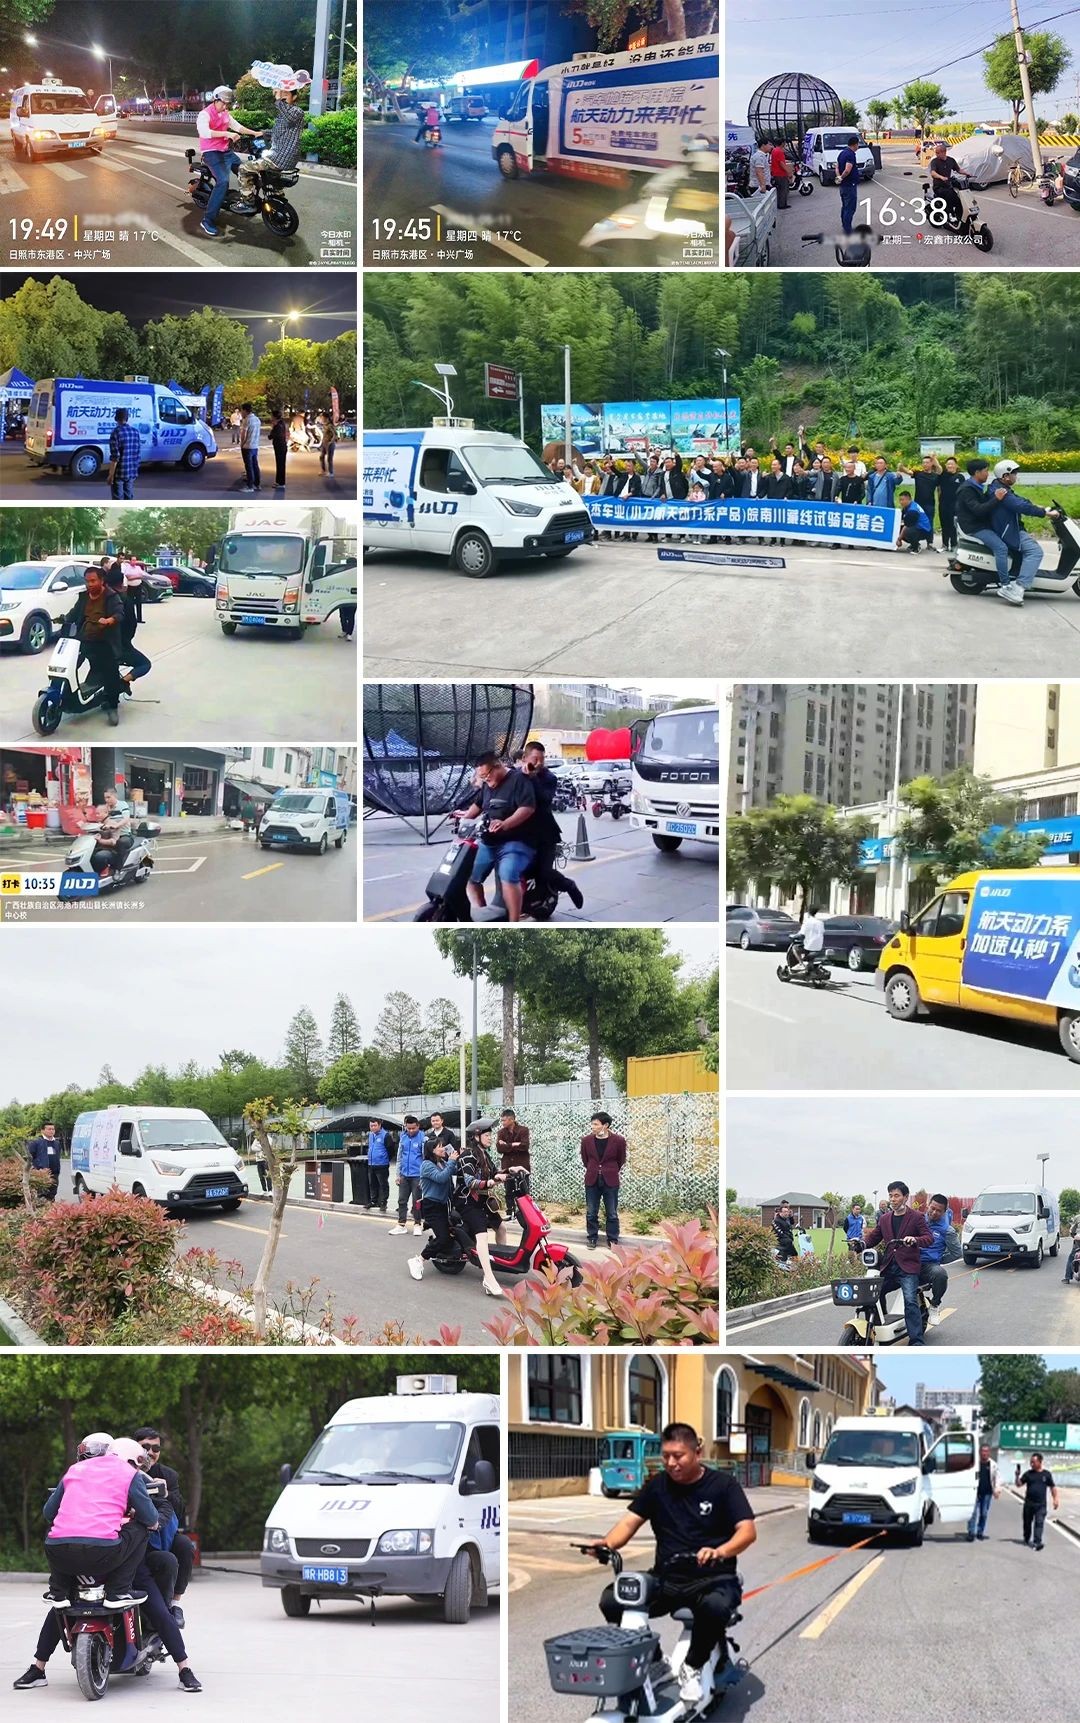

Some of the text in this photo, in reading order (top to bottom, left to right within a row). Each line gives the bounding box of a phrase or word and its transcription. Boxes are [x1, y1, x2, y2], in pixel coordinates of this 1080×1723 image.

[629, 43, 715, 64] 没电还能跑
[570, 105, 707, 125] 航天动力来帮忙
[419, 500, 459, 516] 小刀
[586, 502, 885, 533] 杰车业(小刀航天动力系产品)皖南川藏线试骑品鉴会
[660, 772, 711, 780] FOTON
[977, 910, 1073, 937] 航天动力系
[841, 1285, 850, 1298] 6
